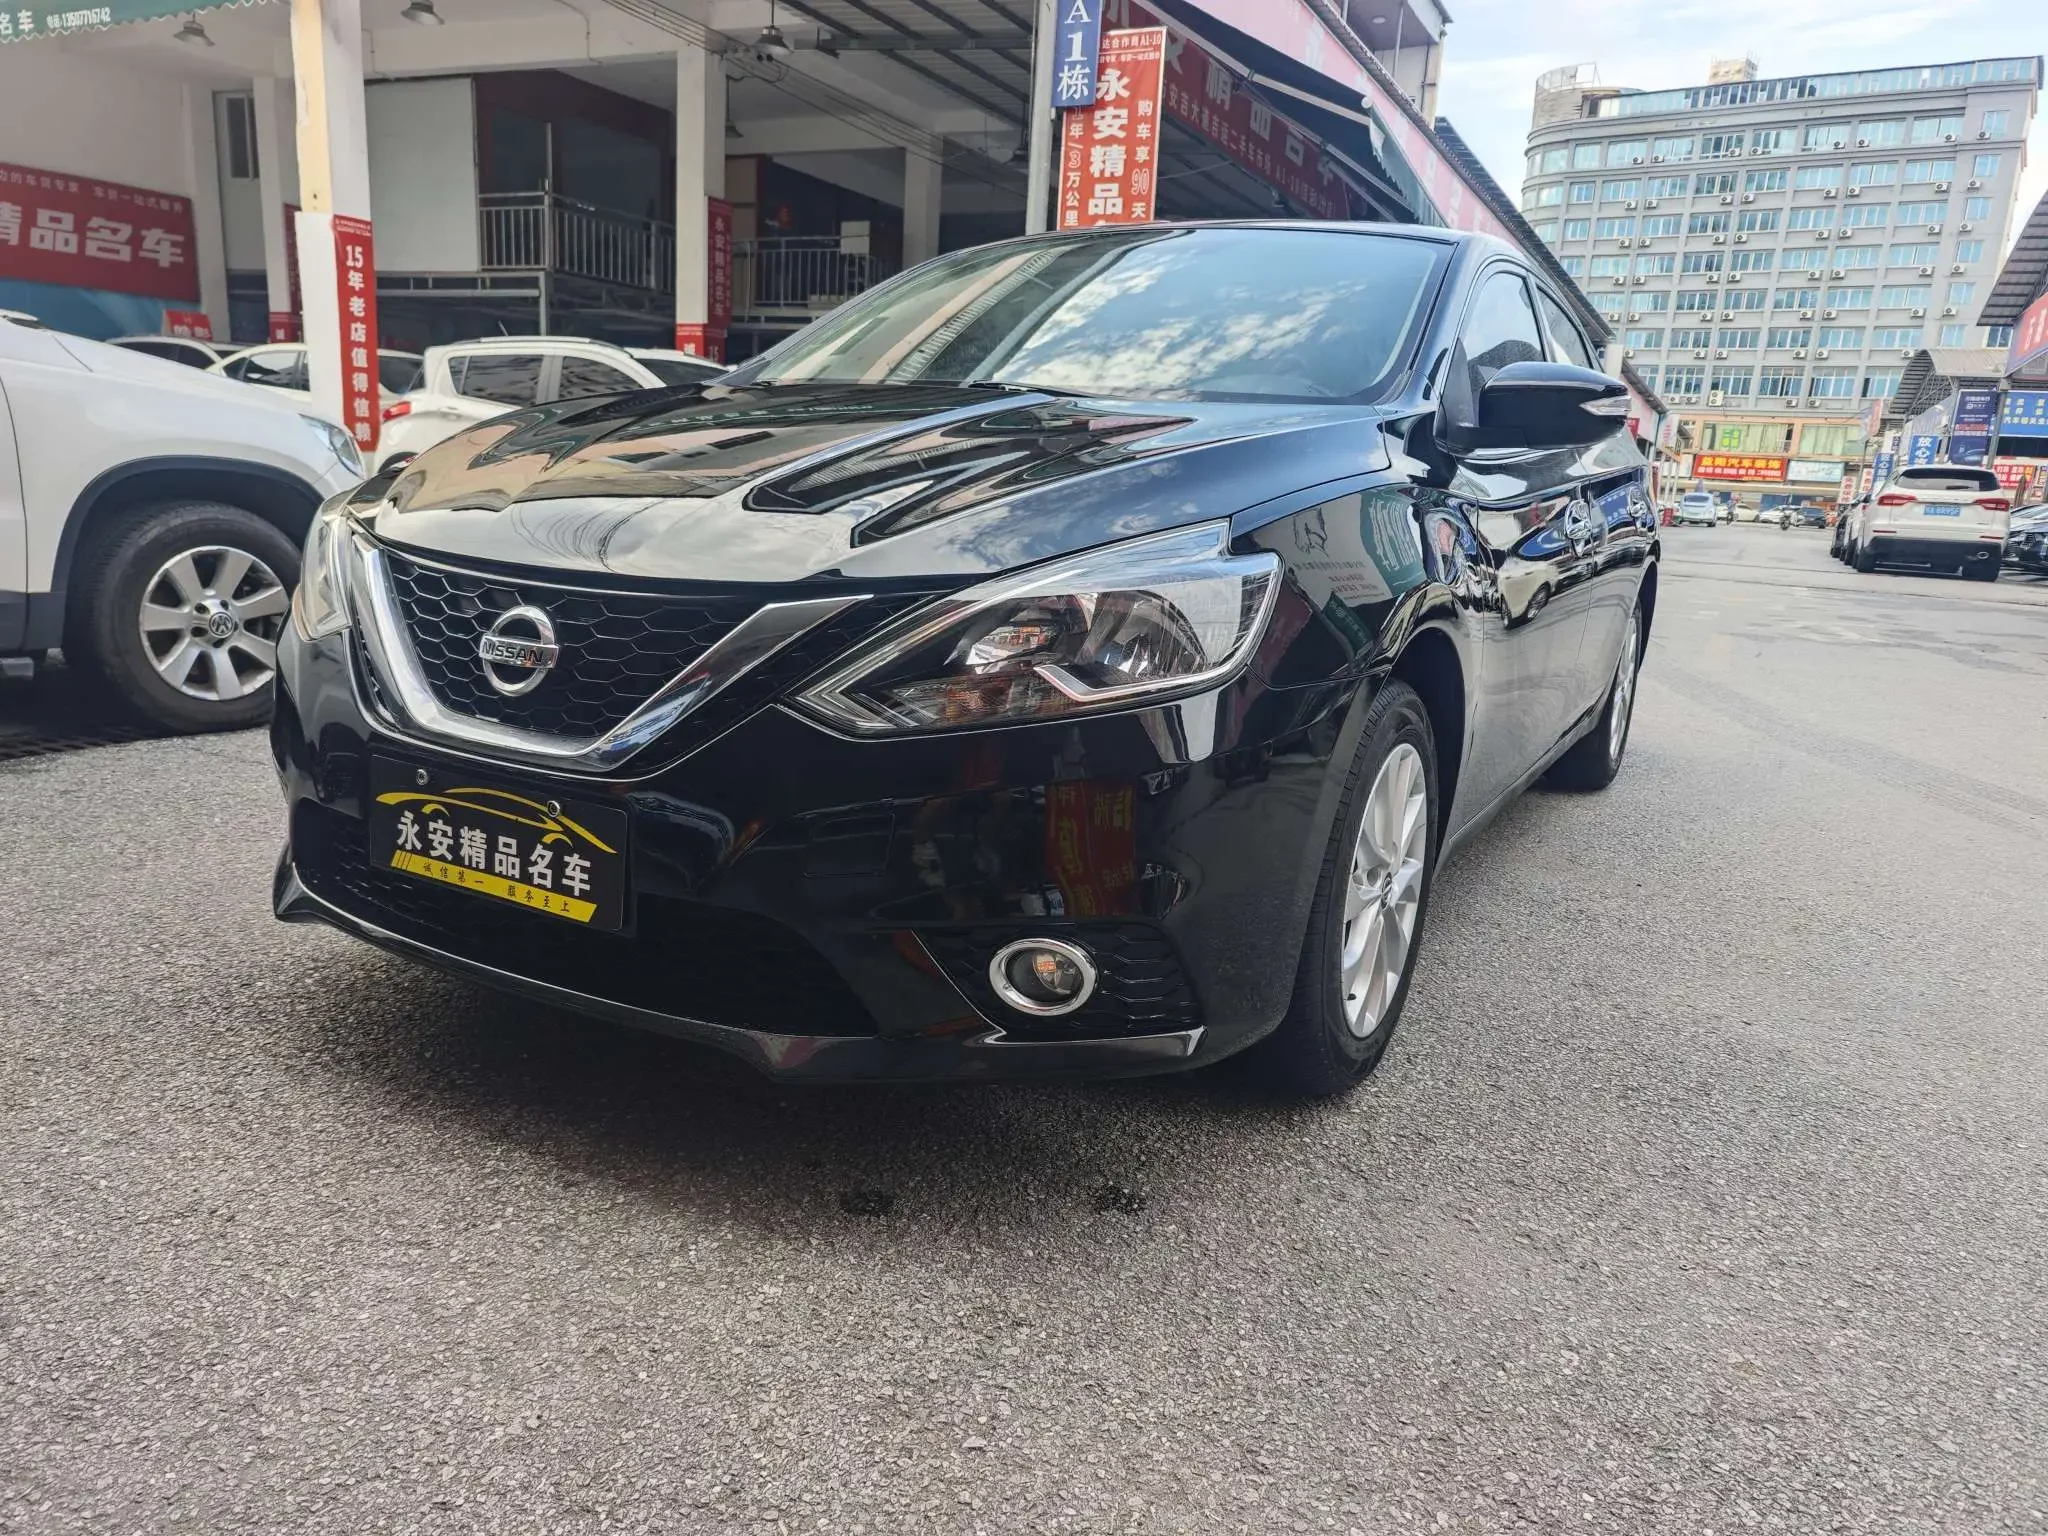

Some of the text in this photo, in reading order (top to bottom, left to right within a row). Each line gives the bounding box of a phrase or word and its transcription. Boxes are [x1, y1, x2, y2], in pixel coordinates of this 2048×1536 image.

[1088, 68, 1131, 226] 永安精品
[482, 638, 545, 665] NISSAN
[396, 809, 592, 897] 永安精品名车
[422, 859, 571, 914] 诚信第一 服务至上
